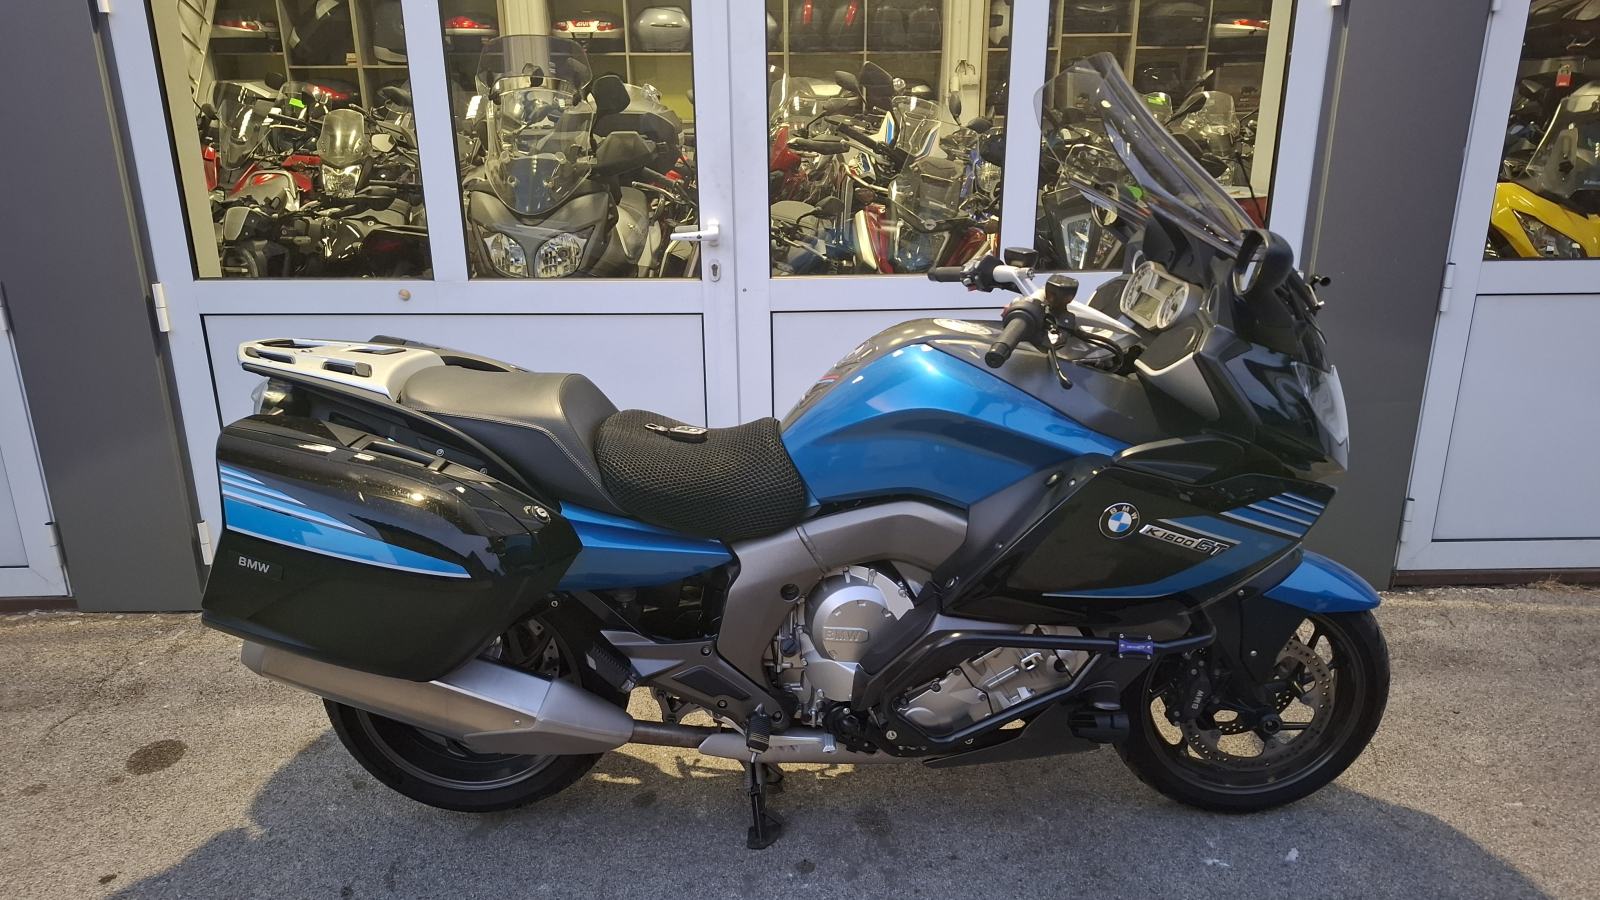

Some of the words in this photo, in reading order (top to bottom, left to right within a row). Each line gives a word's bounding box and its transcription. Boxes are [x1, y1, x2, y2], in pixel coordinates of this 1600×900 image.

[1109, 505, 1139, 520] BMW
[238, 556, 270, 573] BMW
[825, 630, 864, 641] BMW
[1191, 689, 1205, 710] BMW
